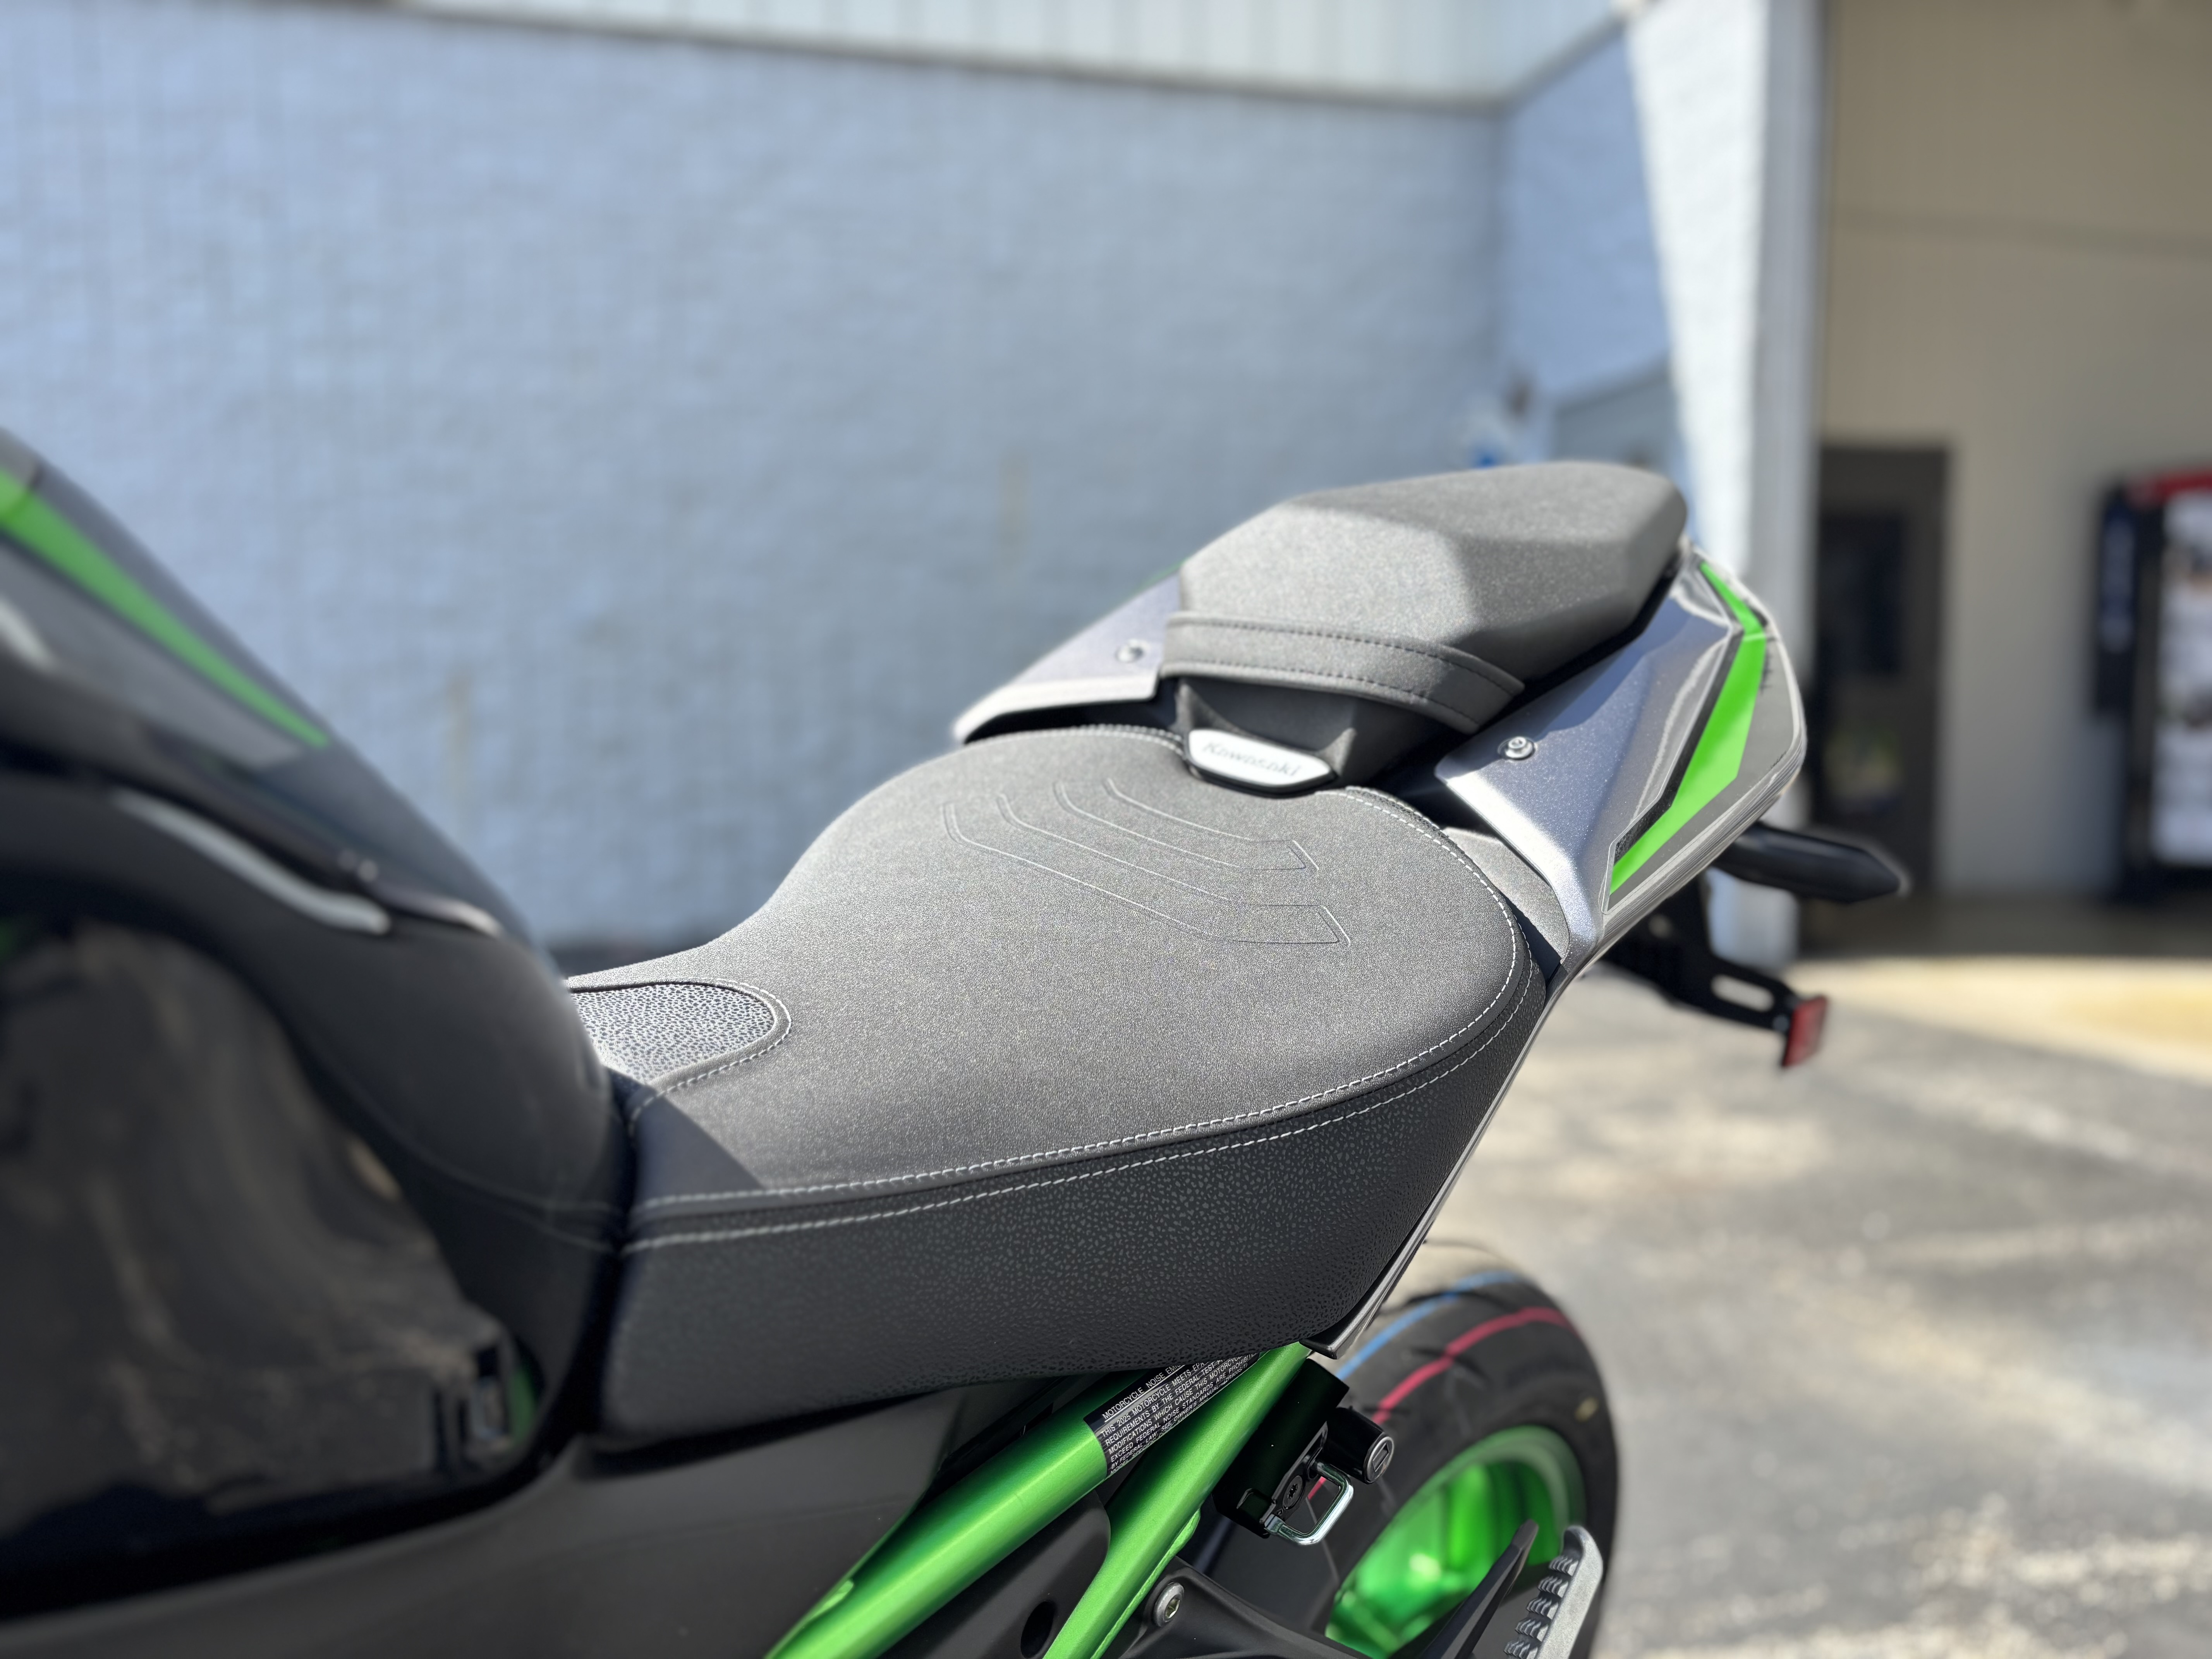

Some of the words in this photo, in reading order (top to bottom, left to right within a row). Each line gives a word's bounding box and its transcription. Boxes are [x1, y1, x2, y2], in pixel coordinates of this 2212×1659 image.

[1202, 742, 1302, 776] Kawasaki
[1101, 1424, 1115, 1437] THIS
[1117, 1414, 1131, 1427] 2025
[1132, 1384, 1171, 1415] MOTORCYCLE
[1172, 1369, 1191, 1386] MEETS
[1102, 1387, 1144, 1420] MOTORCYCLE
[1146, 1372, 1166, 1388] NOISE
[1105, 1410, 1150, 1446] REQUIREMENTS
[1151, 1403, 1159, 1413] BY
[1161, 1393, 1174, 1405] THE
[1175, 1375, 1200, 1396] FEDERAL
[1201, 1362, 1214, 1376] TEST
[1108, 1419, 1152, 1455] MODIFICATIONS
[1154, 1404, 1173, 1421] WHICH
[1175, 1388, 1193, 1405] CAUSE
[1195, 1378, 1207, 1390] THIS
[1111, 1442, 1133, 1462] EXCEED
[1136, 1422, 1161, 1443] FEDERAL
[1163, 1407, 1180, 1423] NOISE
[1182, 1383, 1213, 1409] STANDARDS
[1216, 1372, 1226, 1384] ARE
[1111, 1460, 1118, 1469] BY
[1120, 1443, 1143, 1463] FEDERAL
[1161, 1420, 1172, 1431] SEE
